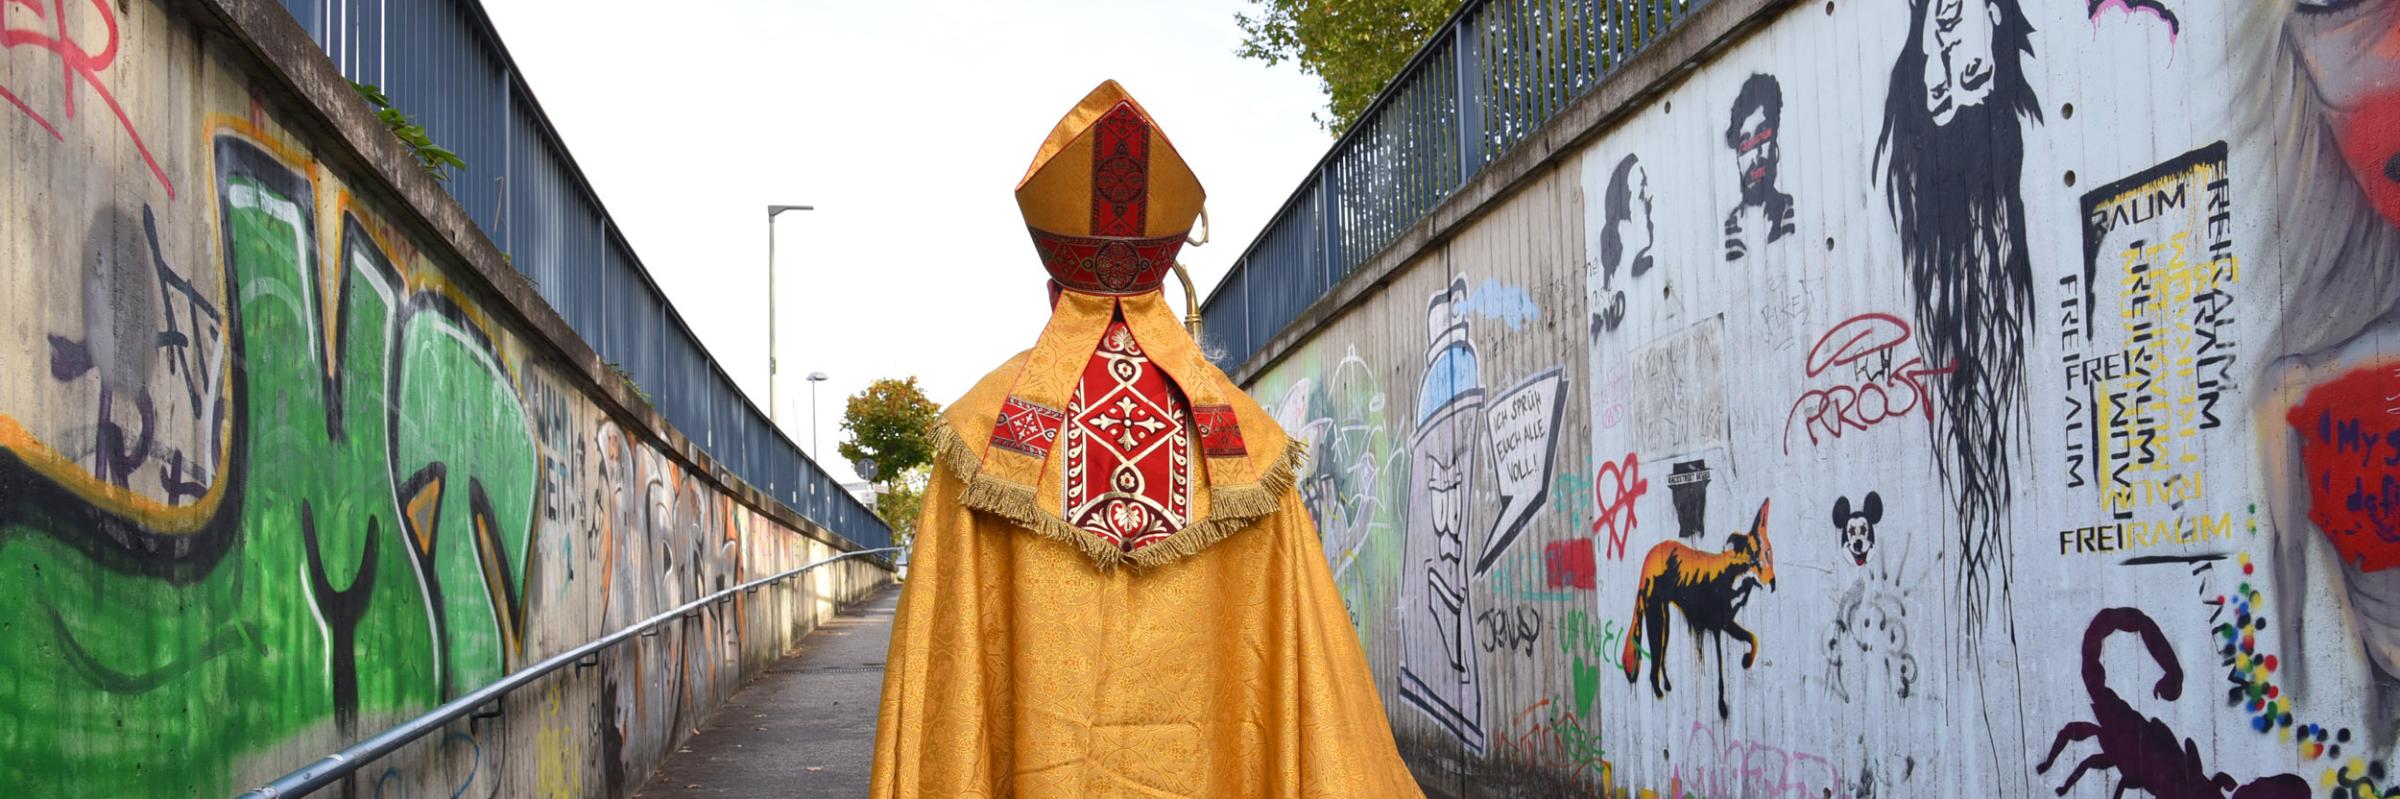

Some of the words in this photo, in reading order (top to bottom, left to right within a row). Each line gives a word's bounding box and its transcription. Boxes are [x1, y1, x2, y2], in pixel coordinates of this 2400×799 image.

[2066, 350, 2131, 391] FREI
[1493, 408, 1508, 433] ICH
[1510, 390, 1542, 421] SPRÜH
[1496, 430, 1522, 463] EUCH
[1524, 419, 1545, 441] ALLE
[1507, 453, 1540, 484] VOLL!
